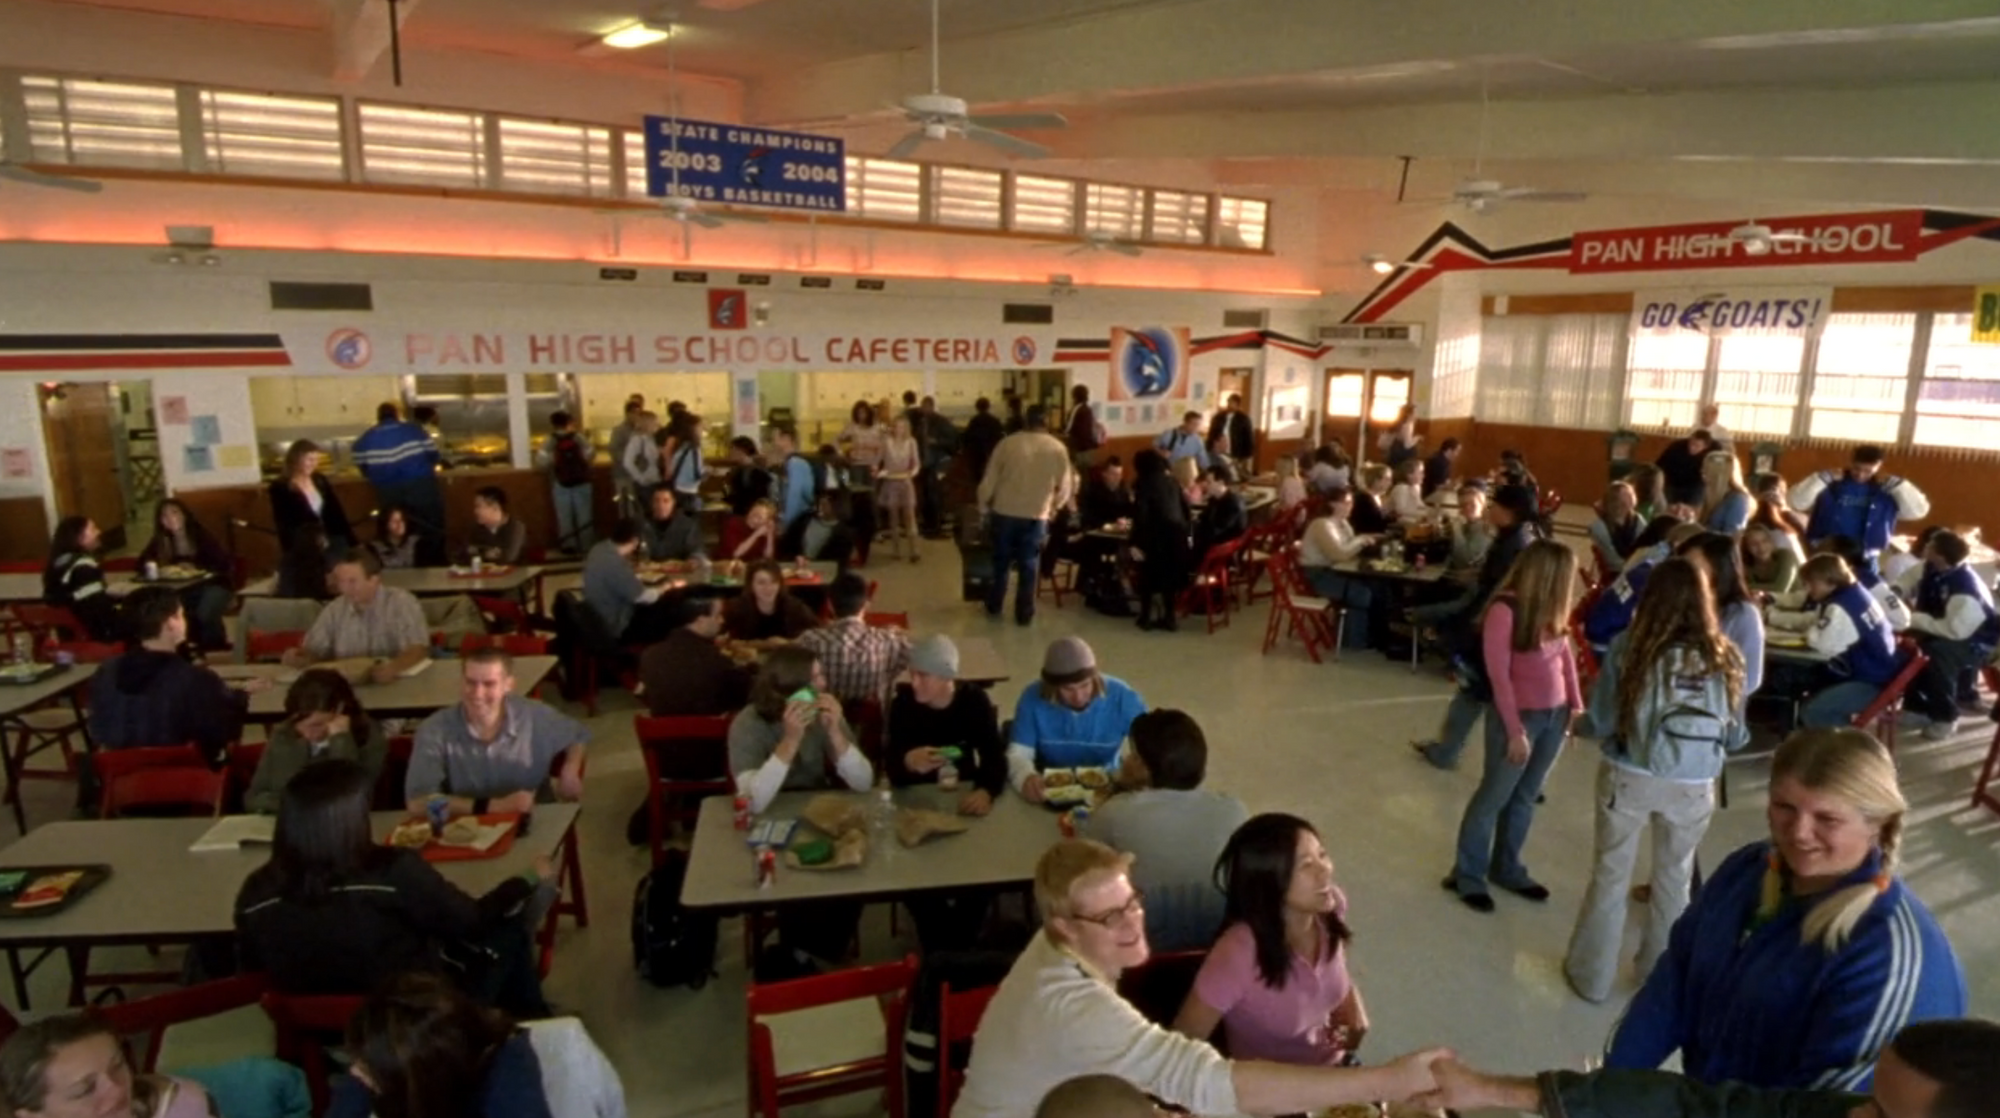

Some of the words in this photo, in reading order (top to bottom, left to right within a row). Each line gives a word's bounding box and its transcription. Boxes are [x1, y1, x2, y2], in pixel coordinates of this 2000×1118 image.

[660, 122, 719, 141] STATE
[727, 130, 837, 155] CHAMPIONS
[659, 149, 722, 173] 2003
[782, 162, 839, 184] 2004
[665, 182, 716, 199] BOYS
[723, 187, 837, 209] BASKETBALL
[1580, 237, 1645, 265] PAN
[1653, 233, 1736, 261] HIGH
[1751, 222, 1904, 257] CHOOL
[1641, 302, 1678, 329] GO
[1711, 299, 1822, 329] GOATS!
[404, 333, 505, 365] PAN
[528, 334, 637, 365] HIGH
[654, 335, 811, 364] SCHOOL
[825, 336, 1001, 364] CAFETERIA
